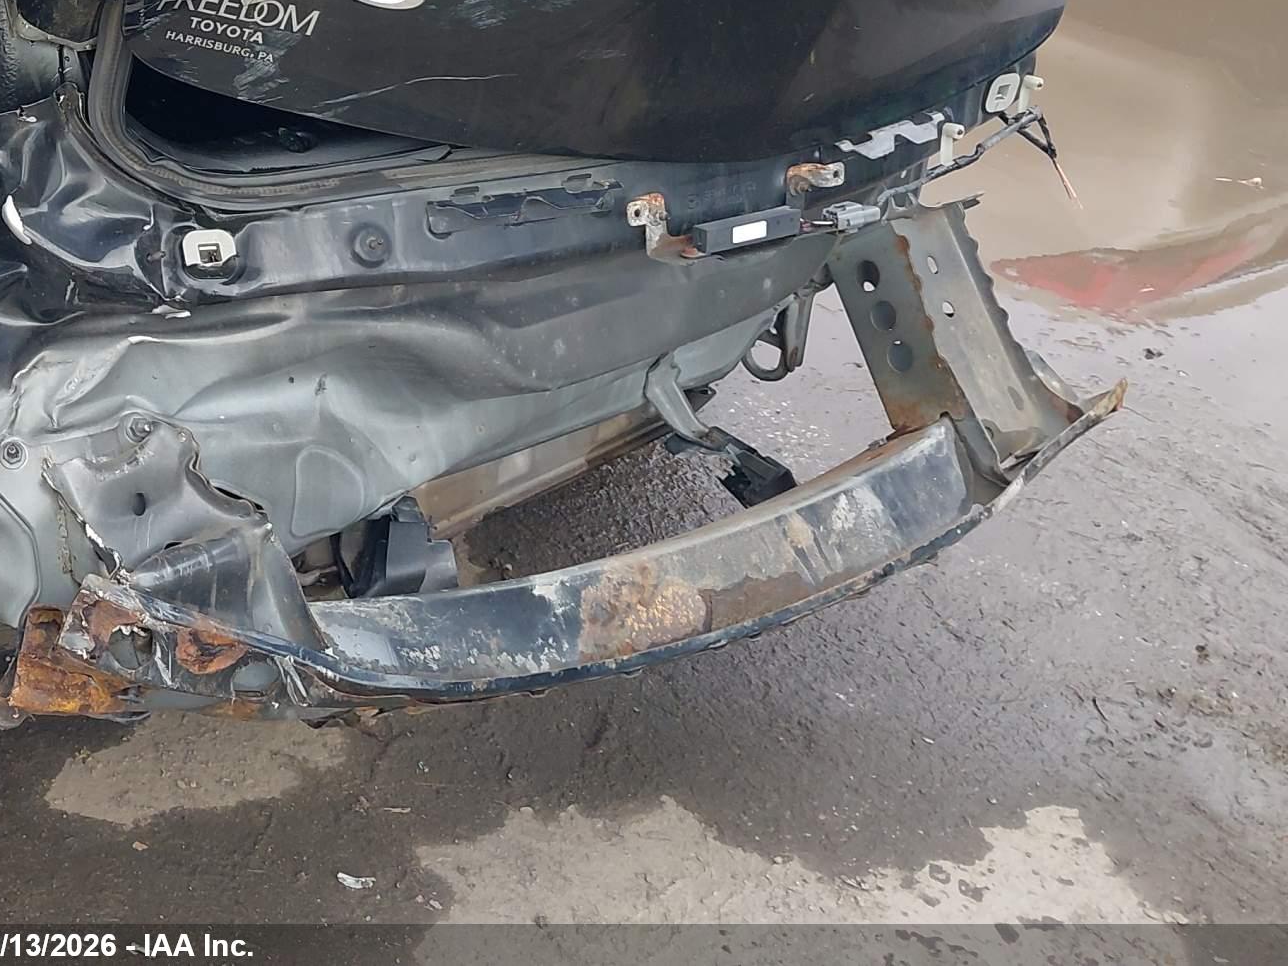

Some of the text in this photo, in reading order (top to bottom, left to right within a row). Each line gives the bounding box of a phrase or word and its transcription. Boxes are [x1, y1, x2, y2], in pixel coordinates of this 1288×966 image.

[190, 16, 263, 44] TOYOTA
[165, 30, 274, 62] HARRISBURG, PA
